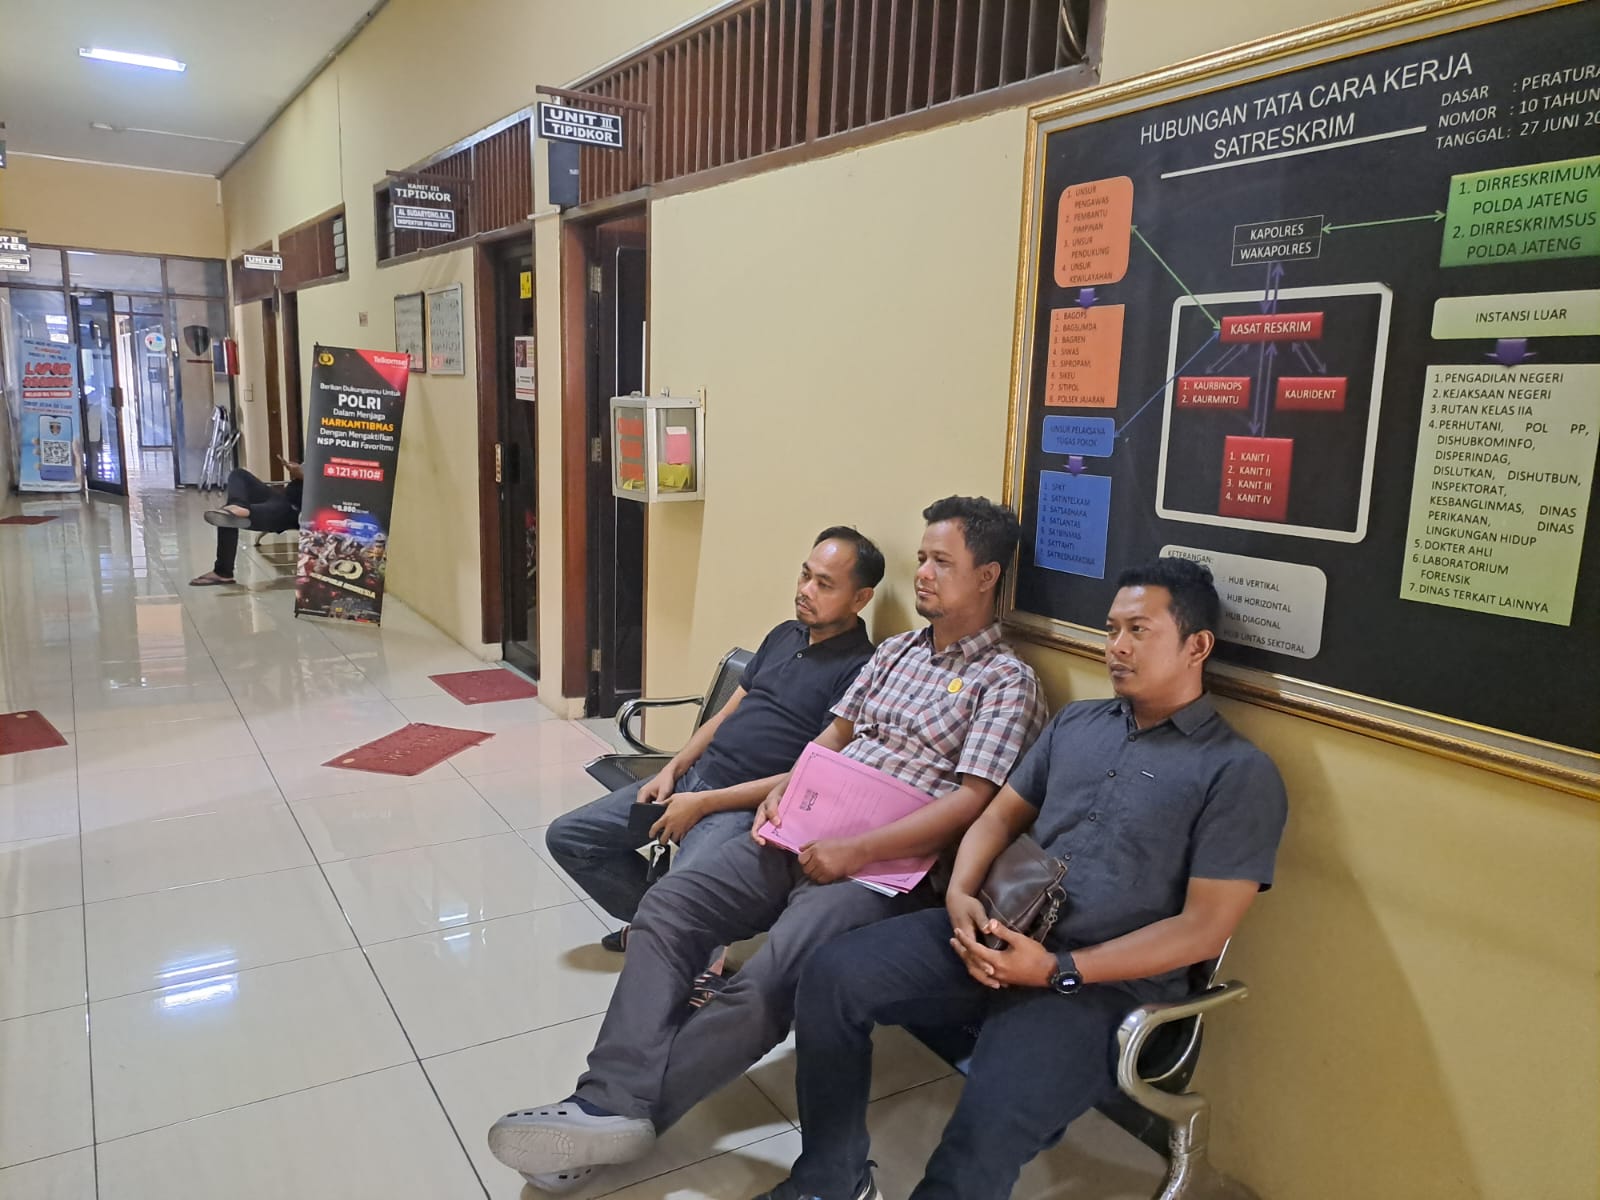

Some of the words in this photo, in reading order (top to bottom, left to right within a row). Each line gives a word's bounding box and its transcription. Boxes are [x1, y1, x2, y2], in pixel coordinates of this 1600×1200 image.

[1140, 104, 1248, 146] HUBUNGAN
[1253, 91, 1304, 120] TATA
[1309, 74, 1377, 108] CARA
[1383, 52, 1473, 93] KERJA
[1441, 86, 1489, 107] DASAR
[1438, 106, 1496, 128] NOMOR
[1519, 98, 1538, 114] 10
[1542, 87, 1600, 110] TAHUN
[550, 109, 597, 125] UNIT
[600, 117, 613, 130] III
[1520, 122, 1538, 136] 27
[1542, 114, 1579, 133] JUNI
[552, 124, 613, 142] TIPIDKOR
[1214, 112, 1356, 160] SATRESKRIM
[1458, 181, 1471, 195] 1.
[1476, 164, 1600, 193] DIRRESKRIMUM
[395, 188, 451, 202] TIPIDKOR
[1473, 197, 1522, 215] POLDA
[1526, 189, 1589, 209] JATENG
[1251, 224, 1304, 240] KAPOLRES
[1452, 225, 1464, 239] 2.
[1470, 211, 1598, 238] DIRRESKRIMSUS
[1072, 246, 1110, 259] PENDUKUNG
[1240, 242, 1312, 259] WAKAPOLRES
[1466, 242, 1517, 260] POLDA
[1520, 236, 1582, 255] JATENG
[1476, 310, 1530, 323] INSTANSI
[1534, 309, 1567, 320] LUAR
[1231, 322, 1260, 334] KASAT
[1264, 321, 1311, 333] RESKRIM
[1194, 382, 1242, 390] KAURBINOPS
[1445, 373, 1516, 383] PENGADILAN
[1520, 373, 1563, 383] NEGERI
[338, 394, 381, 410] POLRI
[1192, 395, 1239, 404] KAURMINTU
[1285, 390, 1336, 399] KAURIDENT
[1443, 389, 1504, 399] KEJAKSAAN
[1508, 390, 1551, 399] NEGERI
[333, 408, 355, 417] Dalam
[356, 410, 385, 421] Menjaga
[1441, 405, 1478, 415] RUTAN
[1482, 406, 1514, 415] KELAS
[1518, 406, 1533, 416] IIA
[320, 428, 347, 438] Dengan
[348, 431, 394, 441] Mengaktifkan
[1439, 420, 1503, 432] PERHUTANI,
[1525, 423, 1548, 433] POL
[1570, 424, 1590, 436] PP,
[336, 439, 359, 448] POLRI
[360, 442, 394, 451] Favoritmu
[1437, 435, 1535, 450] DISHUBKOMINFO,
[1230, 452, 1236, 460] 1.
[1241, 452, 1264, 462] KANIT
[1436, 451, 1511, 465] DISPERINDAG,
[1240, 466, 1263, 477] KANIT
[1266, 469, 1271, 477] II
[1434, 466, 1495, 480] DISLUTKAN,
[1507, 471, 1581, 486] DISHUTBUN,
[1226, 479, 1233, 488] 3.
[1238, 480, 1262, 490] KANIT
[1432, 481, 1507, 496] INSPEKTORAT,
[1237, 494, 1262, 503] KANIT
[1263, 496, 1271, 504] IV
[1430, 496, 1525, 514] KESBANGLINMAS,
[1540, 505, 1577, 518] DINAS
[1428, 510, 1491, 527] PERIKANAN,
[1538, 521, 1574, 534] DINAS
[1426, 526, 1498, 542] LINGKUNGAN
[1500, 535, 1536, 546] HIDUP
[1424, 541, 1465, 554] DOKTER
[1468, 546, 1492, 557] AHLI
[1423, 555, 1509, 574] LABORATORIUM
[1228, 576, 1244, 586] HUB
[1246, 579, 1280, 592] VERTIKAL
[1421, 569, 1471, 585] FORENSIK
[1227, 593, 1242, 603] HUB
[1244, 596, 1291, 613] HORIZONTAL
[1419, 584, 1450, 597] DINAS
[1453, 589, 1496, 605] TERKAIT
[1499, 597, 1549, 613] LAINNYA
[1226, 611, 1241, 621] HUB
[1243, 613, 1280, 630] DIAGONAL
[1224, 630, 1239, 639] HUB
[1240, 632, 1265, 645] LINTAS
[1268, 637, 1305, 654] SEKTORAL
